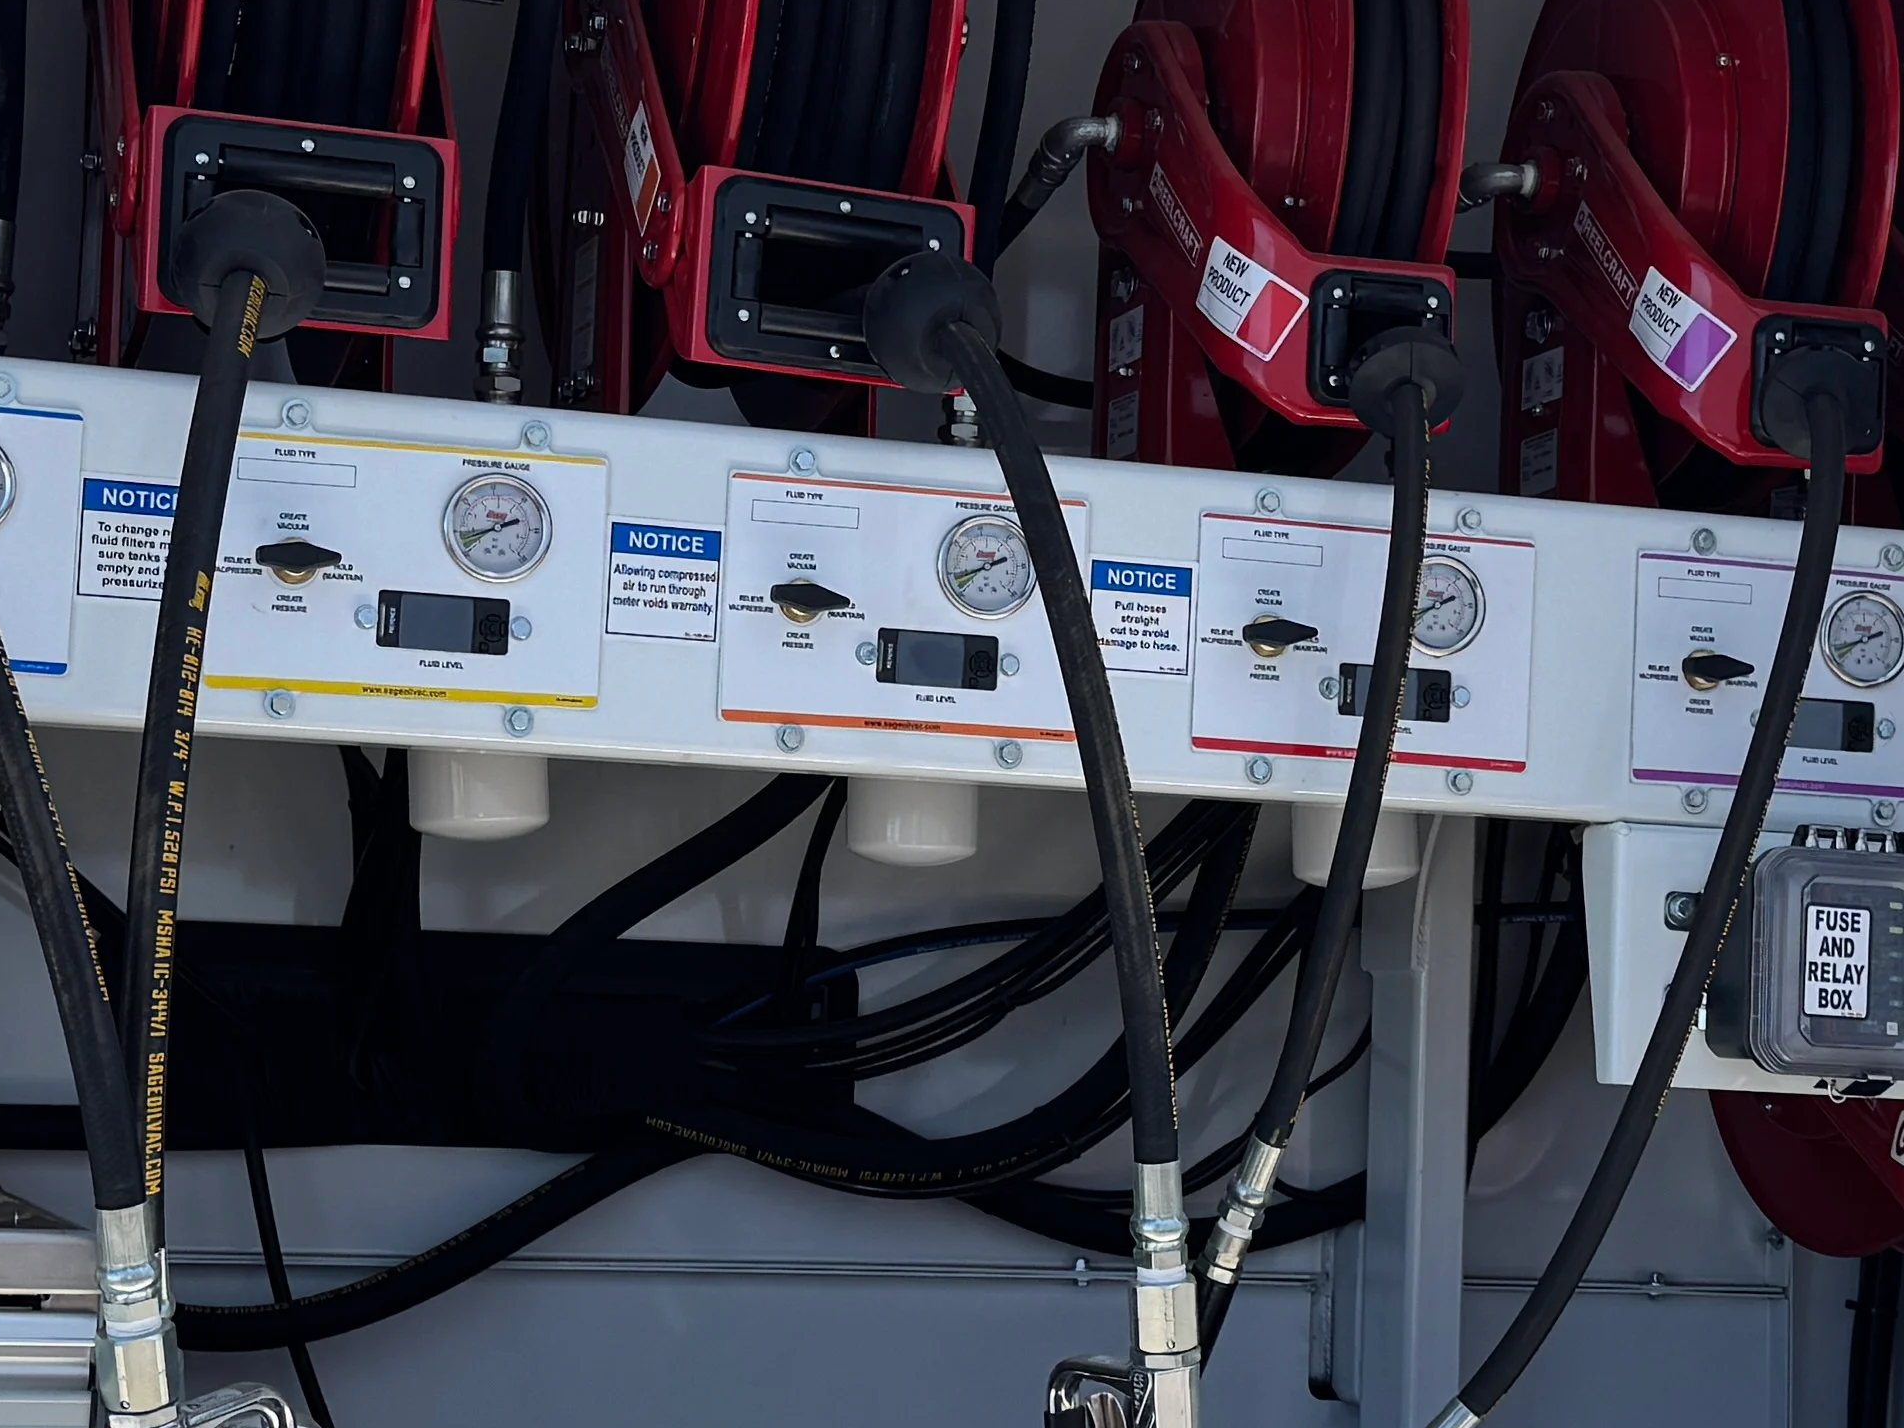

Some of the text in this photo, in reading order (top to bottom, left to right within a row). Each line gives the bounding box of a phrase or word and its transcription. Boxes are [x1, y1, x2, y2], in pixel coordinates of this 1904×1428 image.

[1222, 251, 1250, 278] NEW
[1583, 219, 1634, 302] REELCRAFT
[1207, 265, 1251, 307] PRODUCT
[1656, 283, 1682, 309] NEW
[1640, 294, 1681, 337] PRODUCT
[275, 448, 316, 459] FLUID TYPE
[462, 458, 531, 472] PRESSURE GAUGE
[786, 490, 823, 500] FLUID TYPE
[97, 521, 111, 532] To
[115, 524, 159, 537] change
[92, 534, 118, 546] fluid
[122, 537, 156, 549] filters
[629, 531, 705, 554] NOTICE
[98, 550, 160, 563] sure tanks
[97, 563, 160, 576] empty and
[613, 563, 716, 583] Allowing compressed
[1107, 568, 1177, 590] NOTICE
[623, 580, 706, 599] air to run through
[612, 596, 714, 616] meter voids warranty.
[1115, 601, 1167, 614] Pull hoses
[1121, 615, 1160, 627] straight
[1110, 627, 1169, 639] out to avoid
[1097, 637, 1180, 652] damage to hose.
[1815, 909, 1861, 933] FUSE
[155, 909, 174, 959] MSHA
[1819, 935, 1855, 959] AND
[1808, 961, 1865, 985] RELAY
[1818, 987, 1853, 1011] BOX
